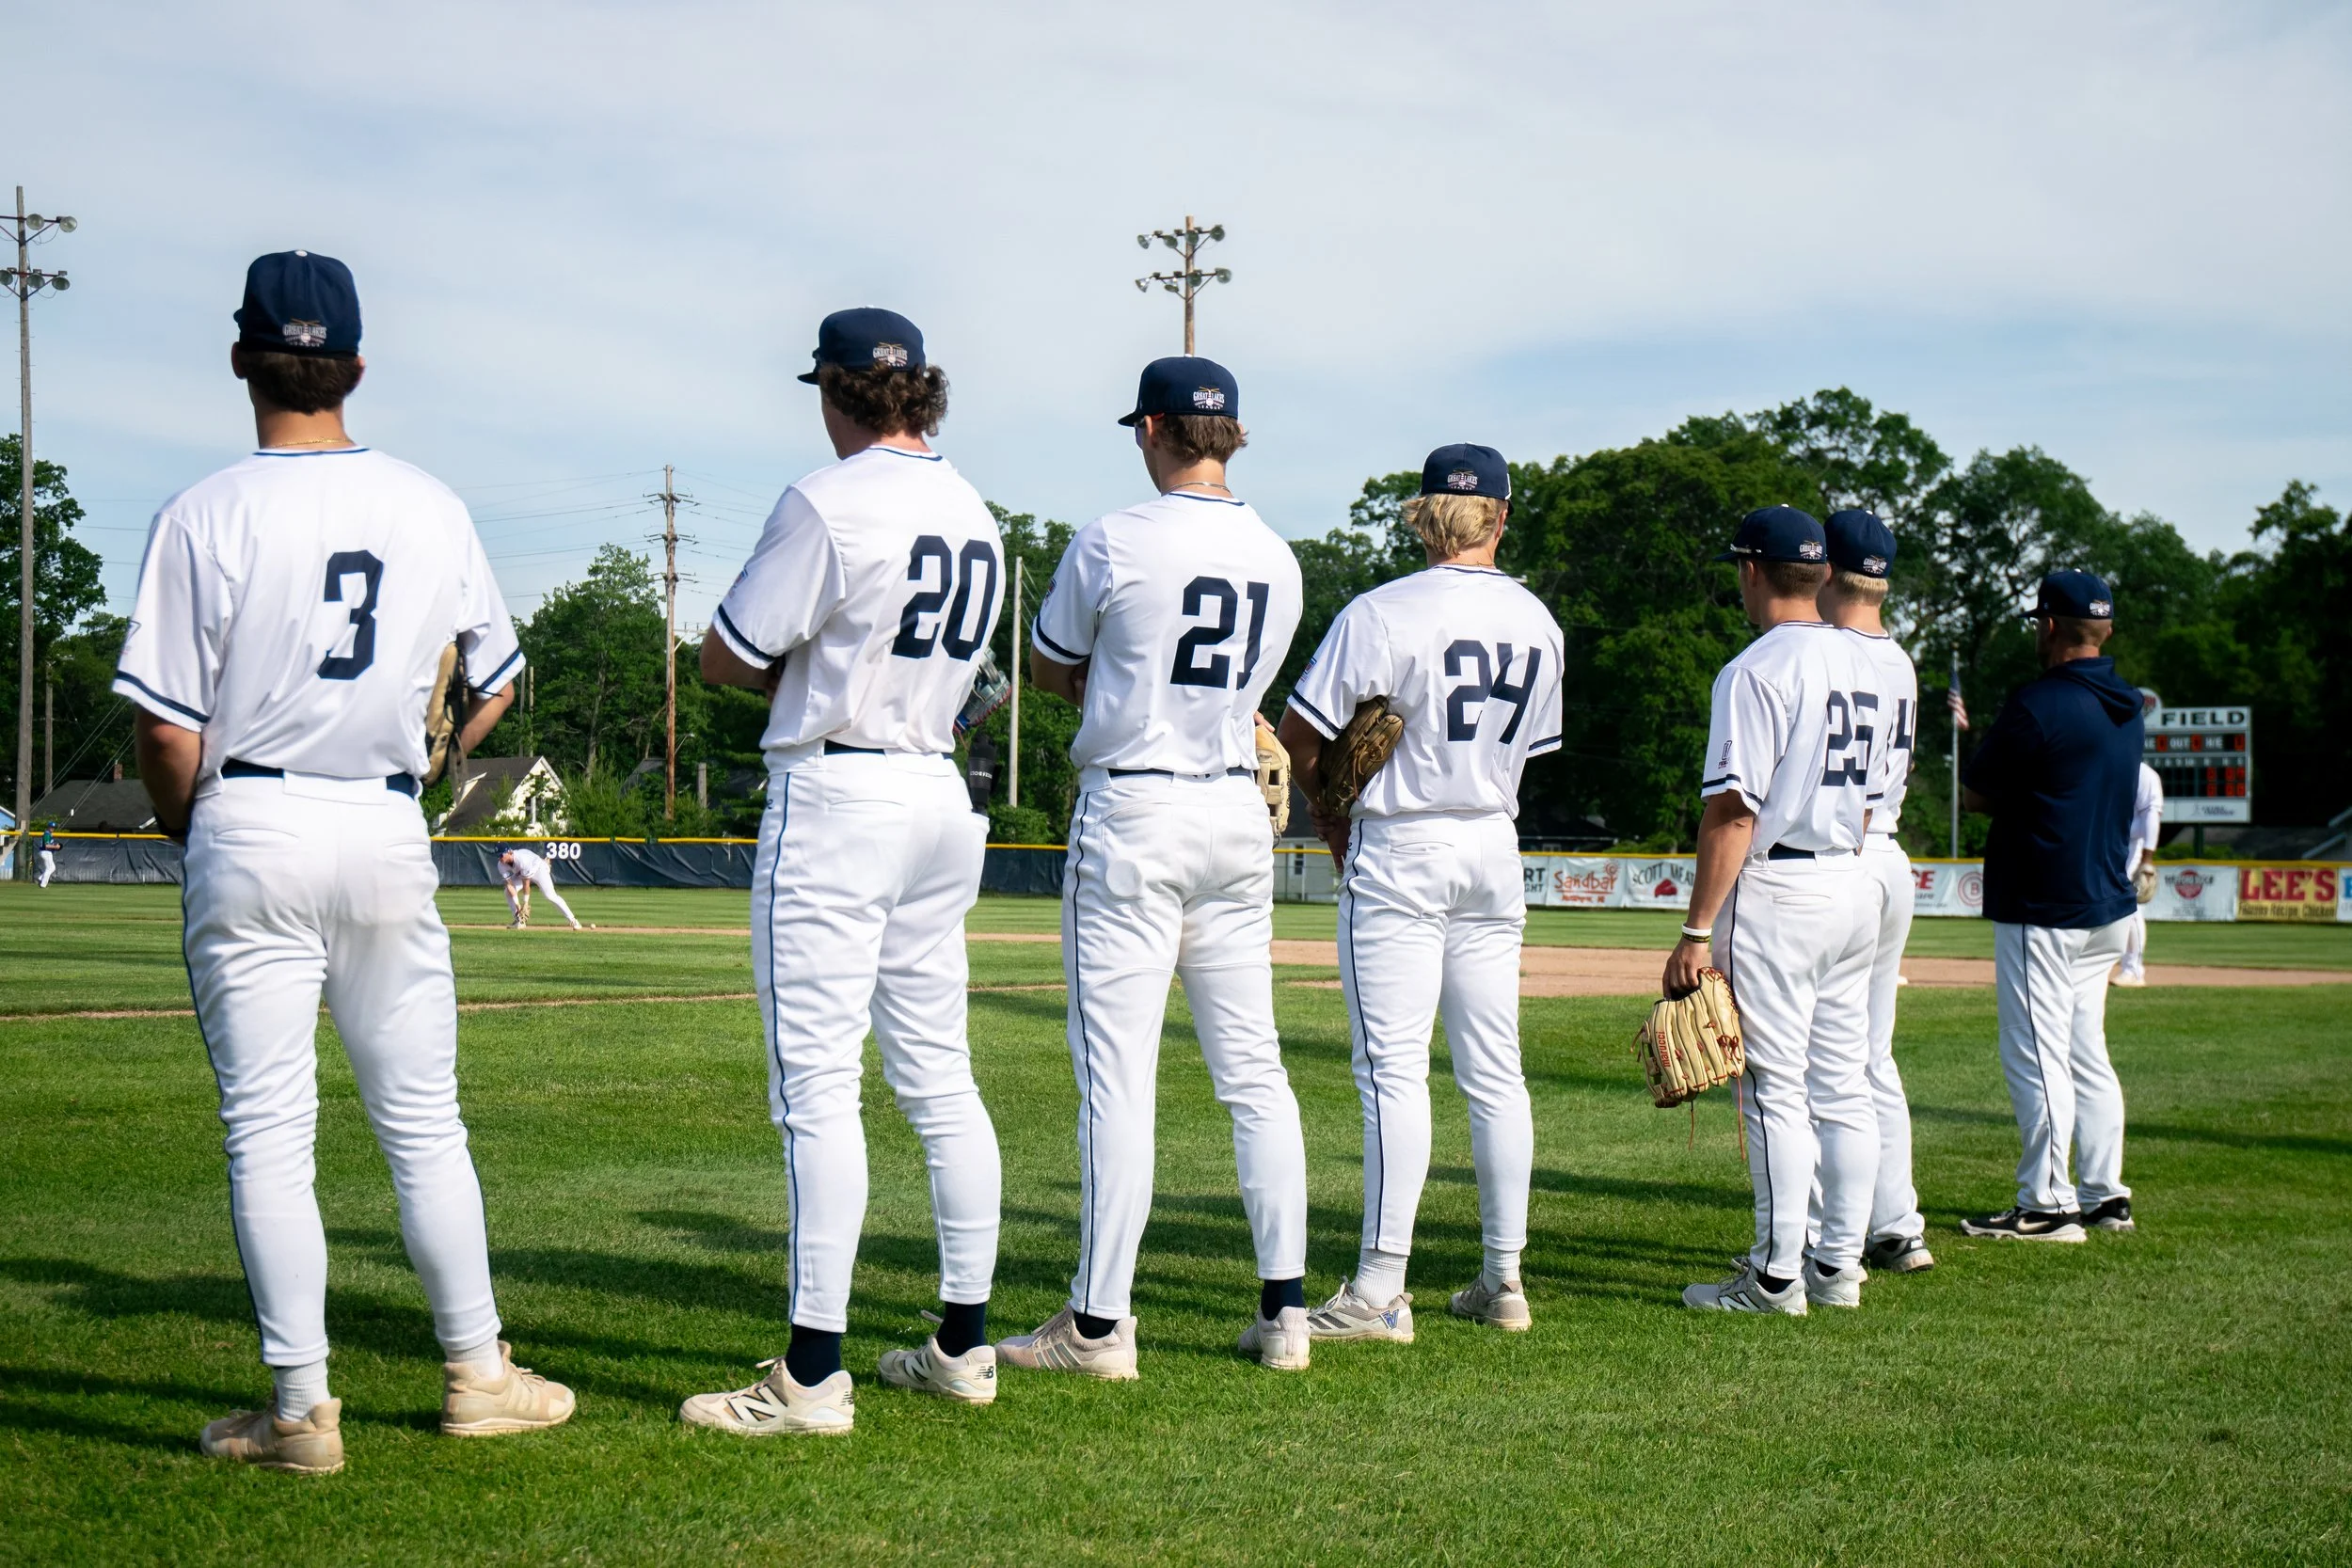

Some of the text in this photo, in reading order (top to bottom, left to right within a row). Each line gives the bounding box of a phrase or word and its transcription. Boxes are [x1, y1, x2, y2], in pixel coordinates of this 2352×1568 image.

[1193, 391, 1208, 401] GREAT
[316, 549, 384, 680] 3
[891, 534, 997, 662] 20
[1169, 576, 1270, 690] 21
[1443, 639, 1542, 745] 24
[2161, 711, 2245, 726] FIELD
[1820, 689, 1879, 786] 25
[2169, 736, 2190, 750] OUT
[546, 842, 581, 860] 380
[1554, 869, 1618, 891] Sandbar
[1632, 862, 1664, 885] SCOTT
[2241, 868, 2336, 901] LEE'S
[1656, 1031, 1671, 1068] marucci
